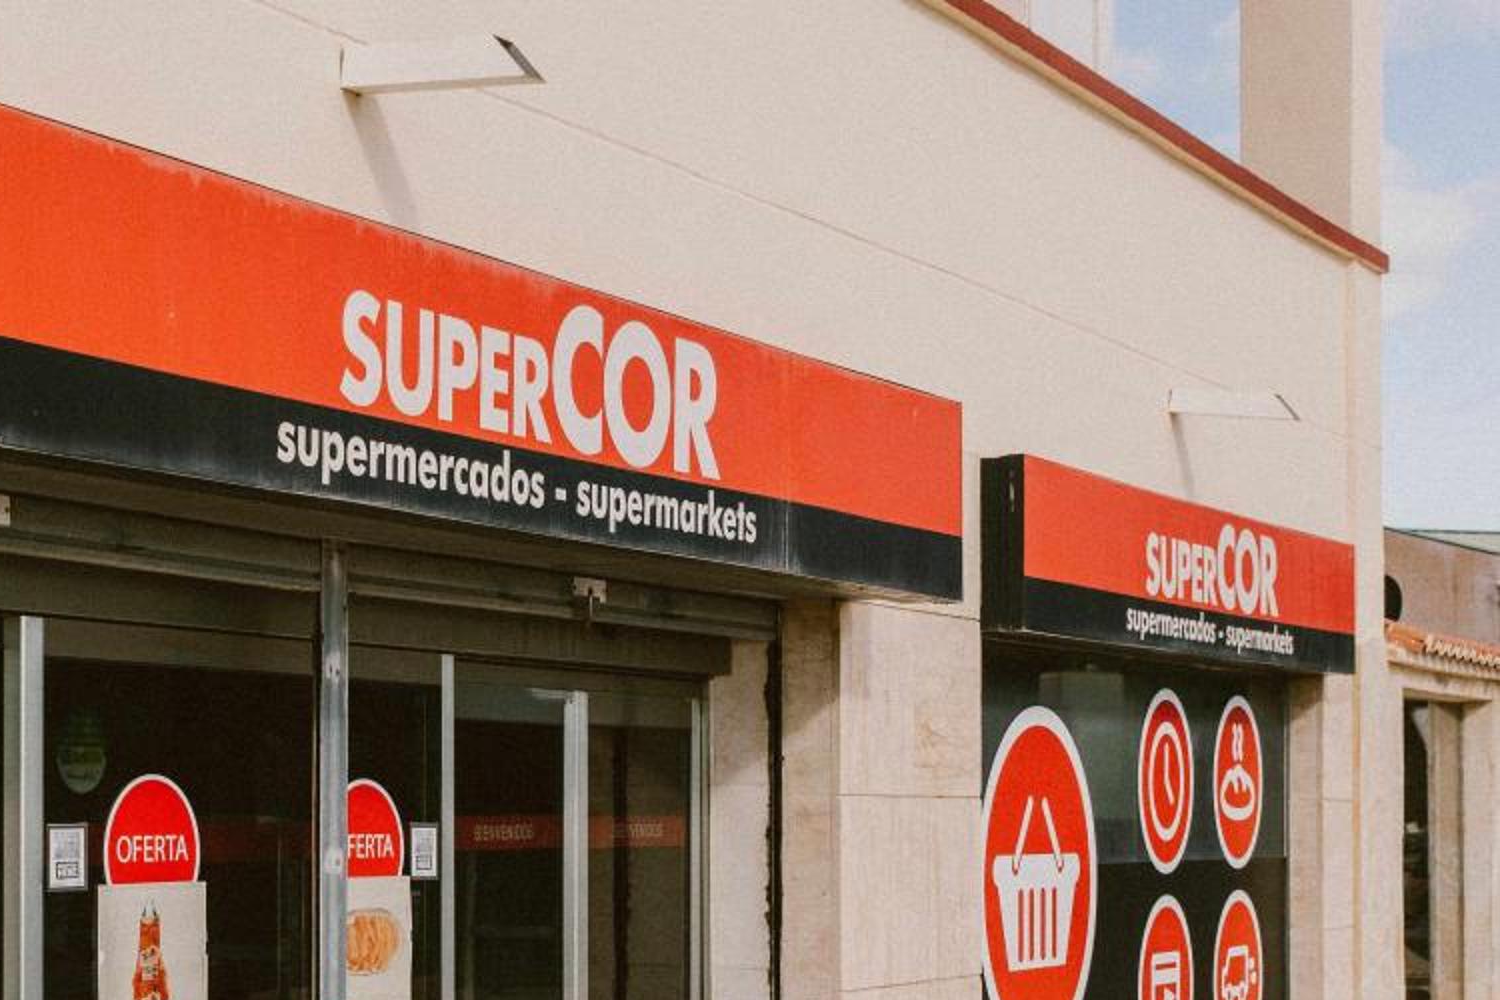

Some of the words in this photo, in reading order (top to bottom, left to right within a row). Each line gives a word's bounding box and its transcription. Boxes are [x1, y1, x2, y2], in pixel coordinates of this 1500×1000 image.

[339, 290, 721, 479] SUPERCOR
[277, 421, 545, 508] supermercados
[576, 480, 757, 543] supermarkets
[1145, 523, 1279, 617] SUPERCOR
[1126, 607, 1217, 644] supermercados
[1225, 624, 1294, 655] supermarkets
[115, 834, 190, 866] OFERTA
[347, 833, 395, 860] FERTA
